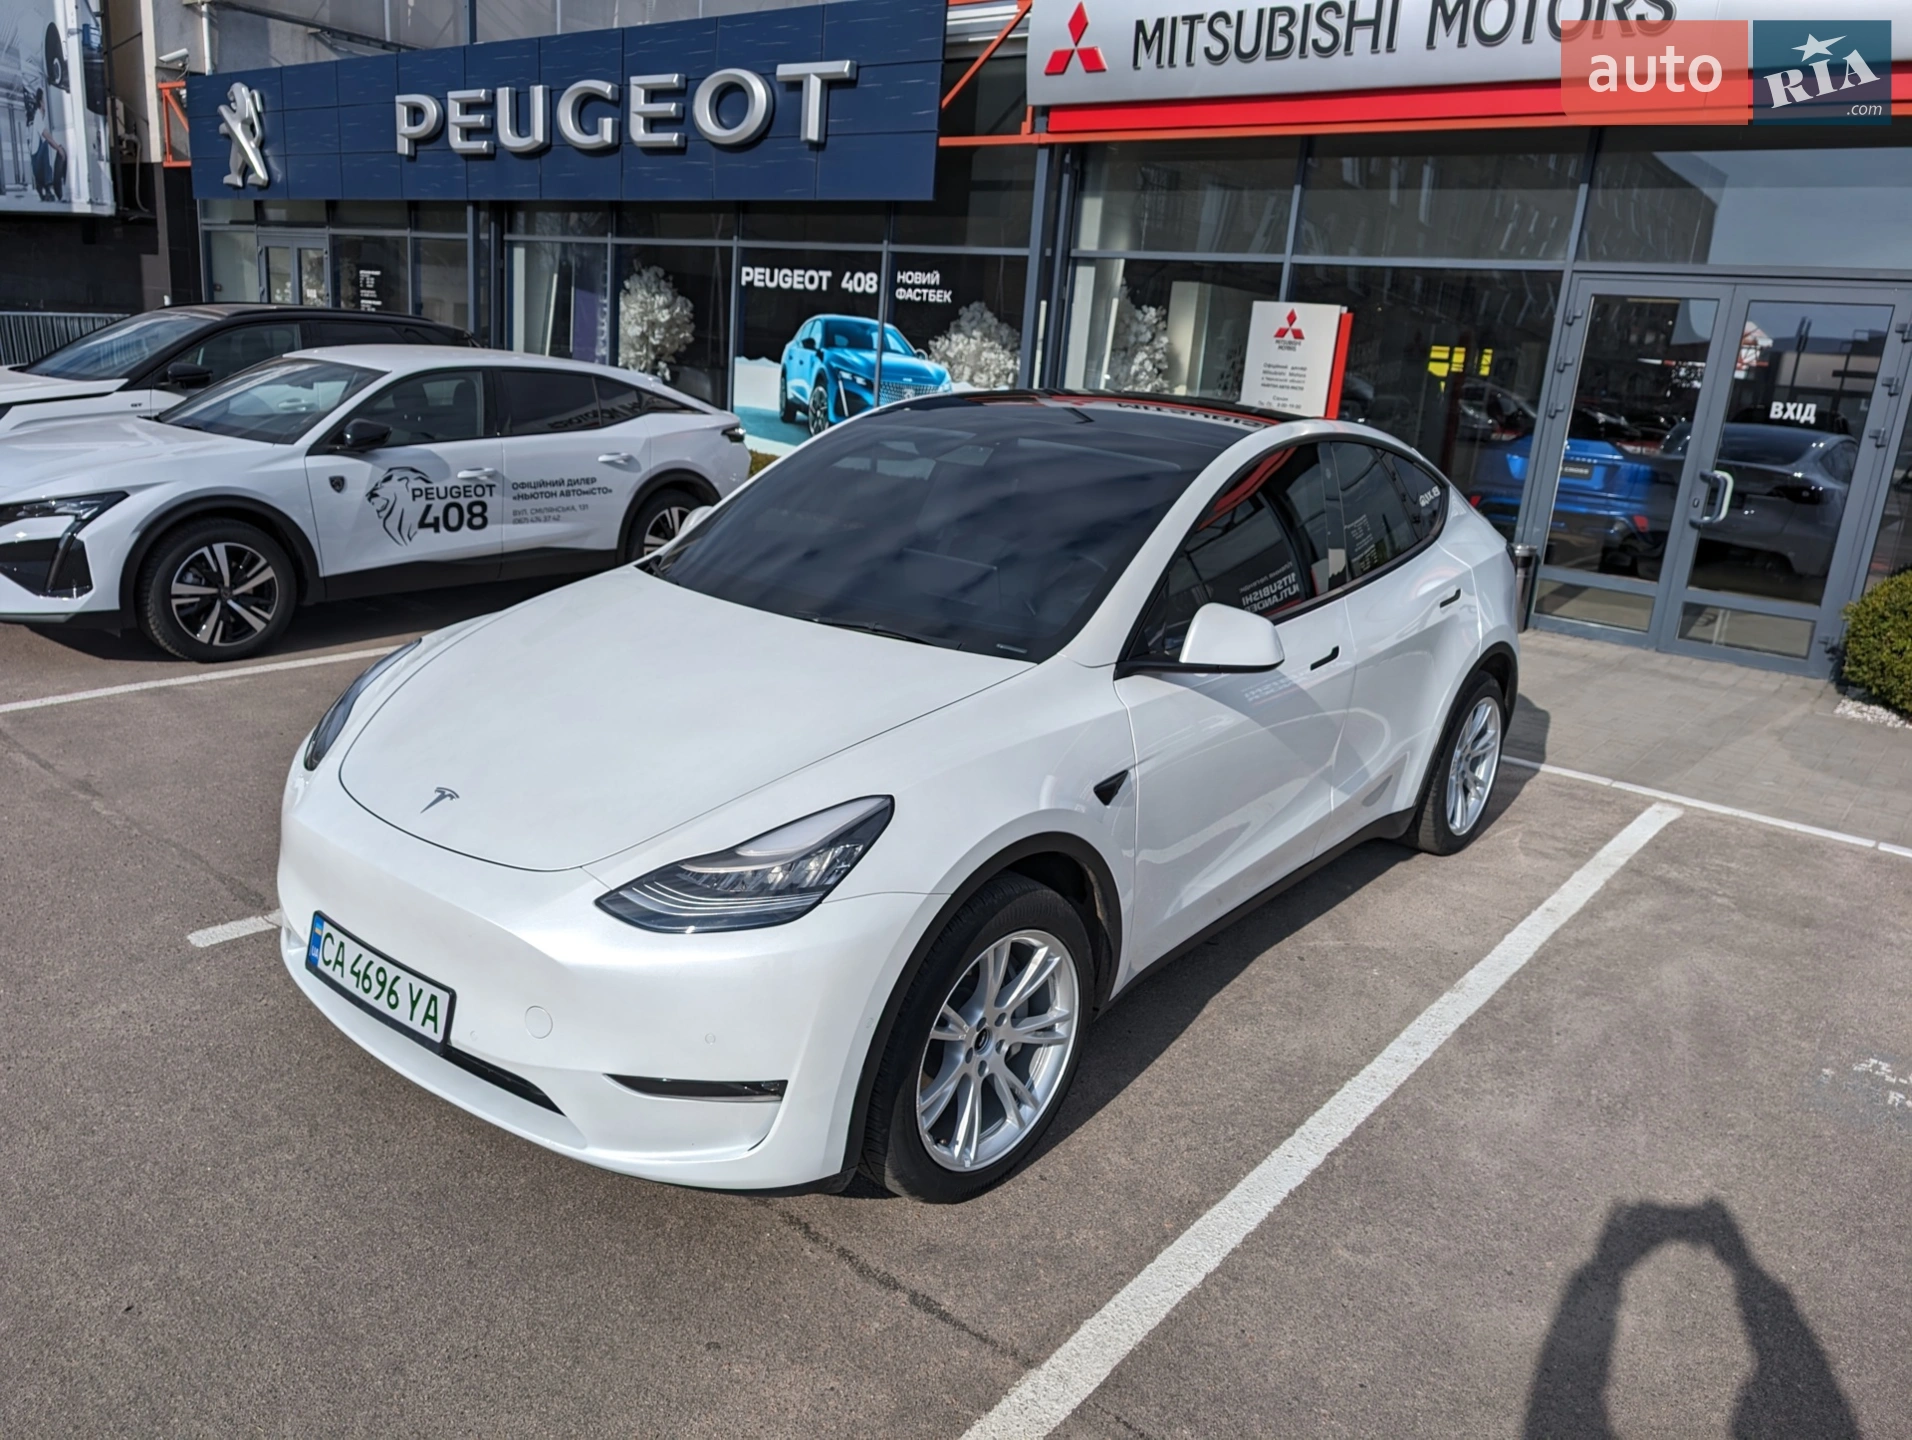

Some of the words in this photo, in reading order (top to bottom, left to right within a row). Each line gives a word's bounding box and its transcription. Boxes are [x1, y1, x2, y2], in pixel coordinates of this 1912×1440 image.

[1132, 0, 1400, 70] MITSUBISHI
[395, 59, 858, 157] PEUGEOT
[741, 266, 832, 291] PEUGEOT
[841, 271, 878, 294] 408
[896, 270, 941, 286] НОВИЙ
[895, 288, 952, 304] ФАСТБЕК
[1770, 401, 1817, 425] ВХІД
[411, 484, 496, 501] PEUGEOT
[511, 477, 565, 491] ОФІЦІЙНИЙ
[566, 476, 597, 488] ДИЛЕР
[417, 501, 488, 534] 408
[321, 932, 345, 979] CA
[350, 953, 401, 1010] 4696
[408, 982, 438, 1034] YA
